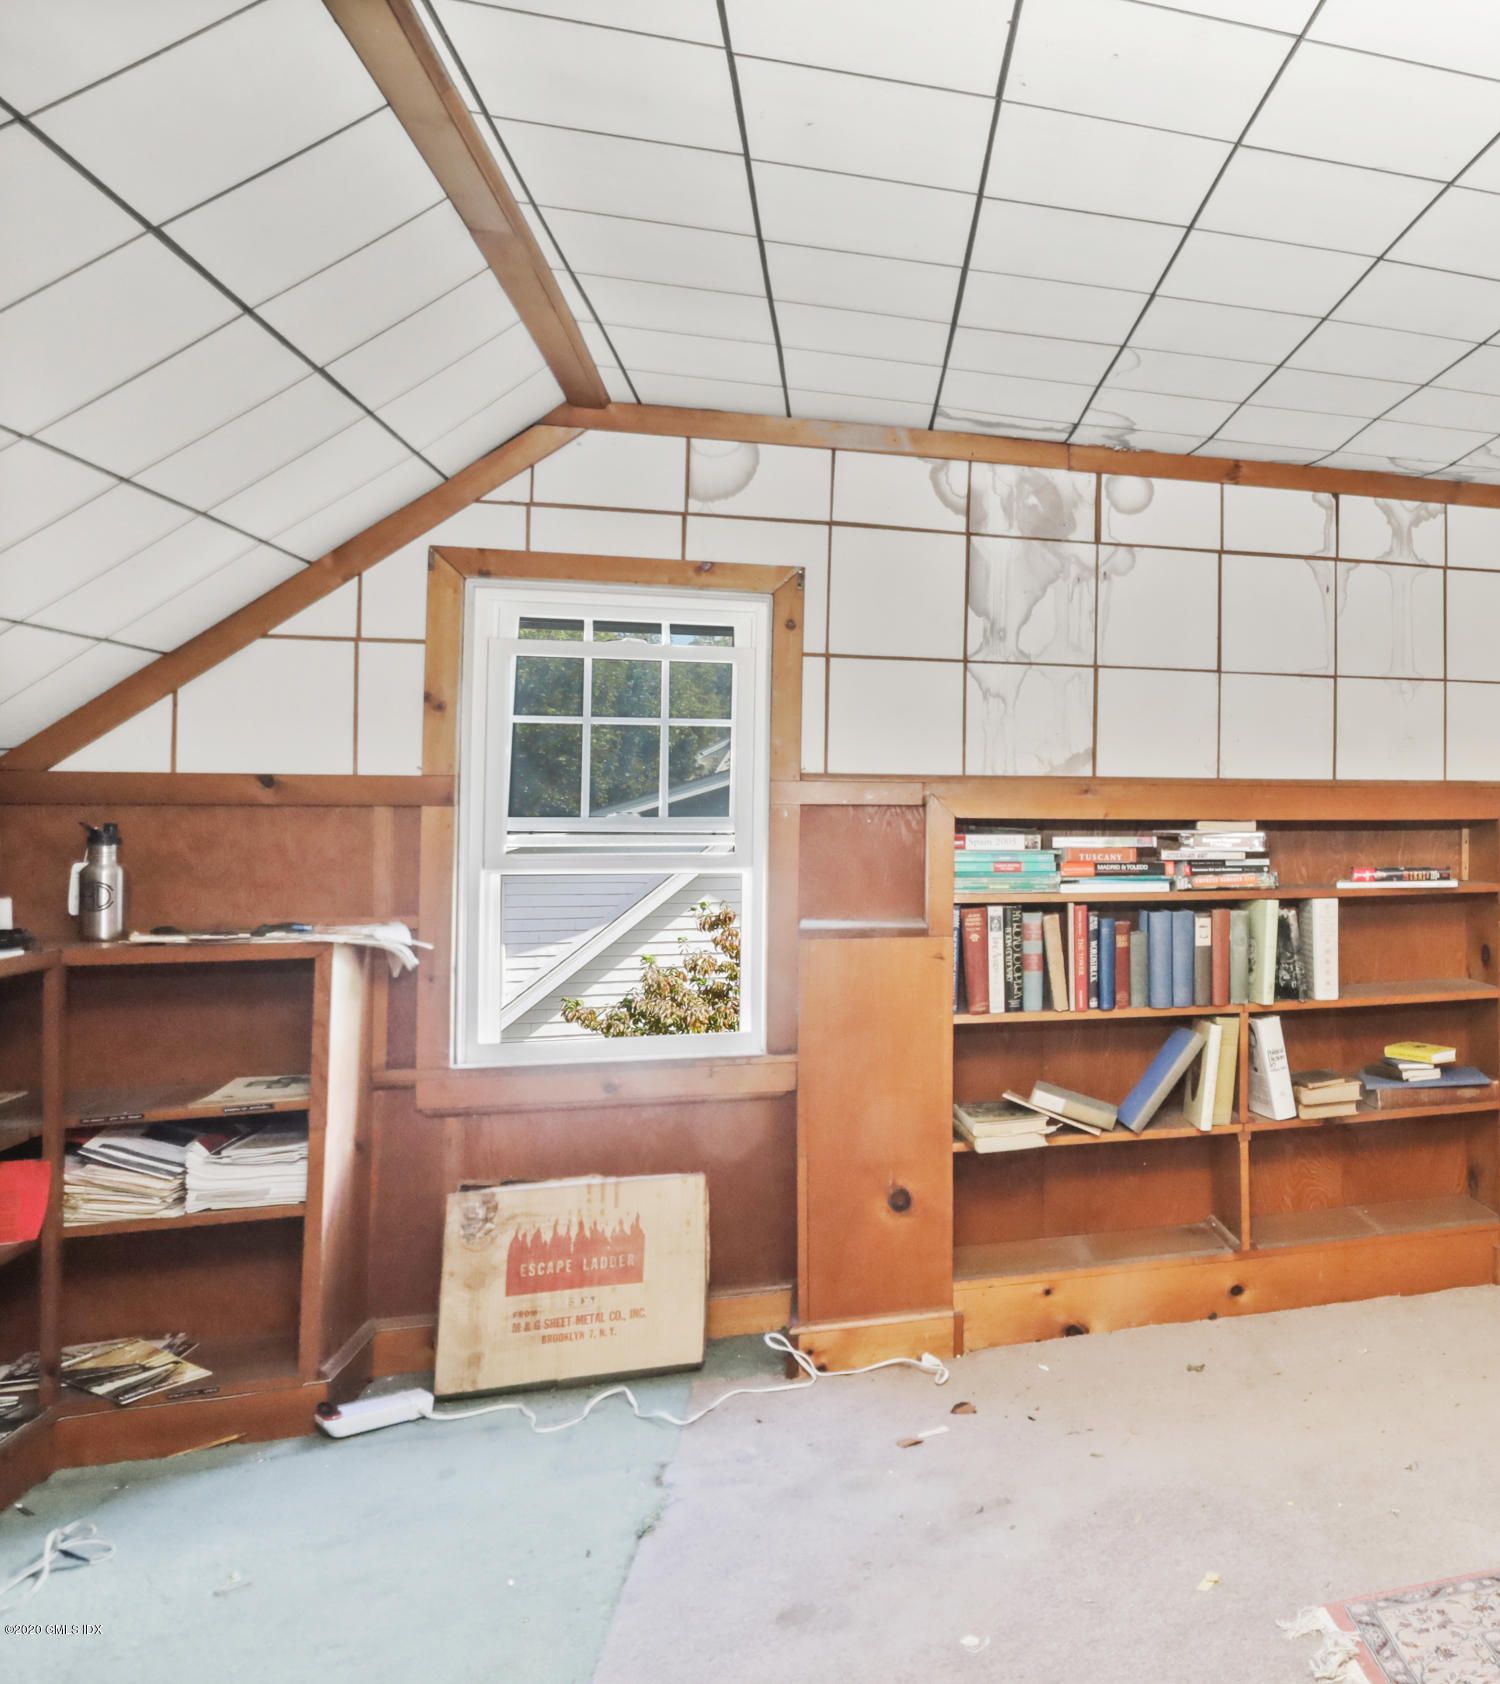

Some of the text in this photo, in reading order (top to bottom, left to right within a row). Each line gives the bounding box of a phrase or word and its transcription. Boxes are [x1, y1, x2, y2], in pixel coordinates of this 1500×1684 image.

[1079, 853, 1123, 861] TUSCANY
[520, 1254, 635, 1277] ESCAPE LADDER
[512, 1309, 538, 1319] FROM
[543, 1315, 572, 1330] SHEET
[575, 1312, 604, 1326] METAL
[629, 1307, 648, 1319] INC.
[541, 1330, 585, 1344] BROOKLYN
